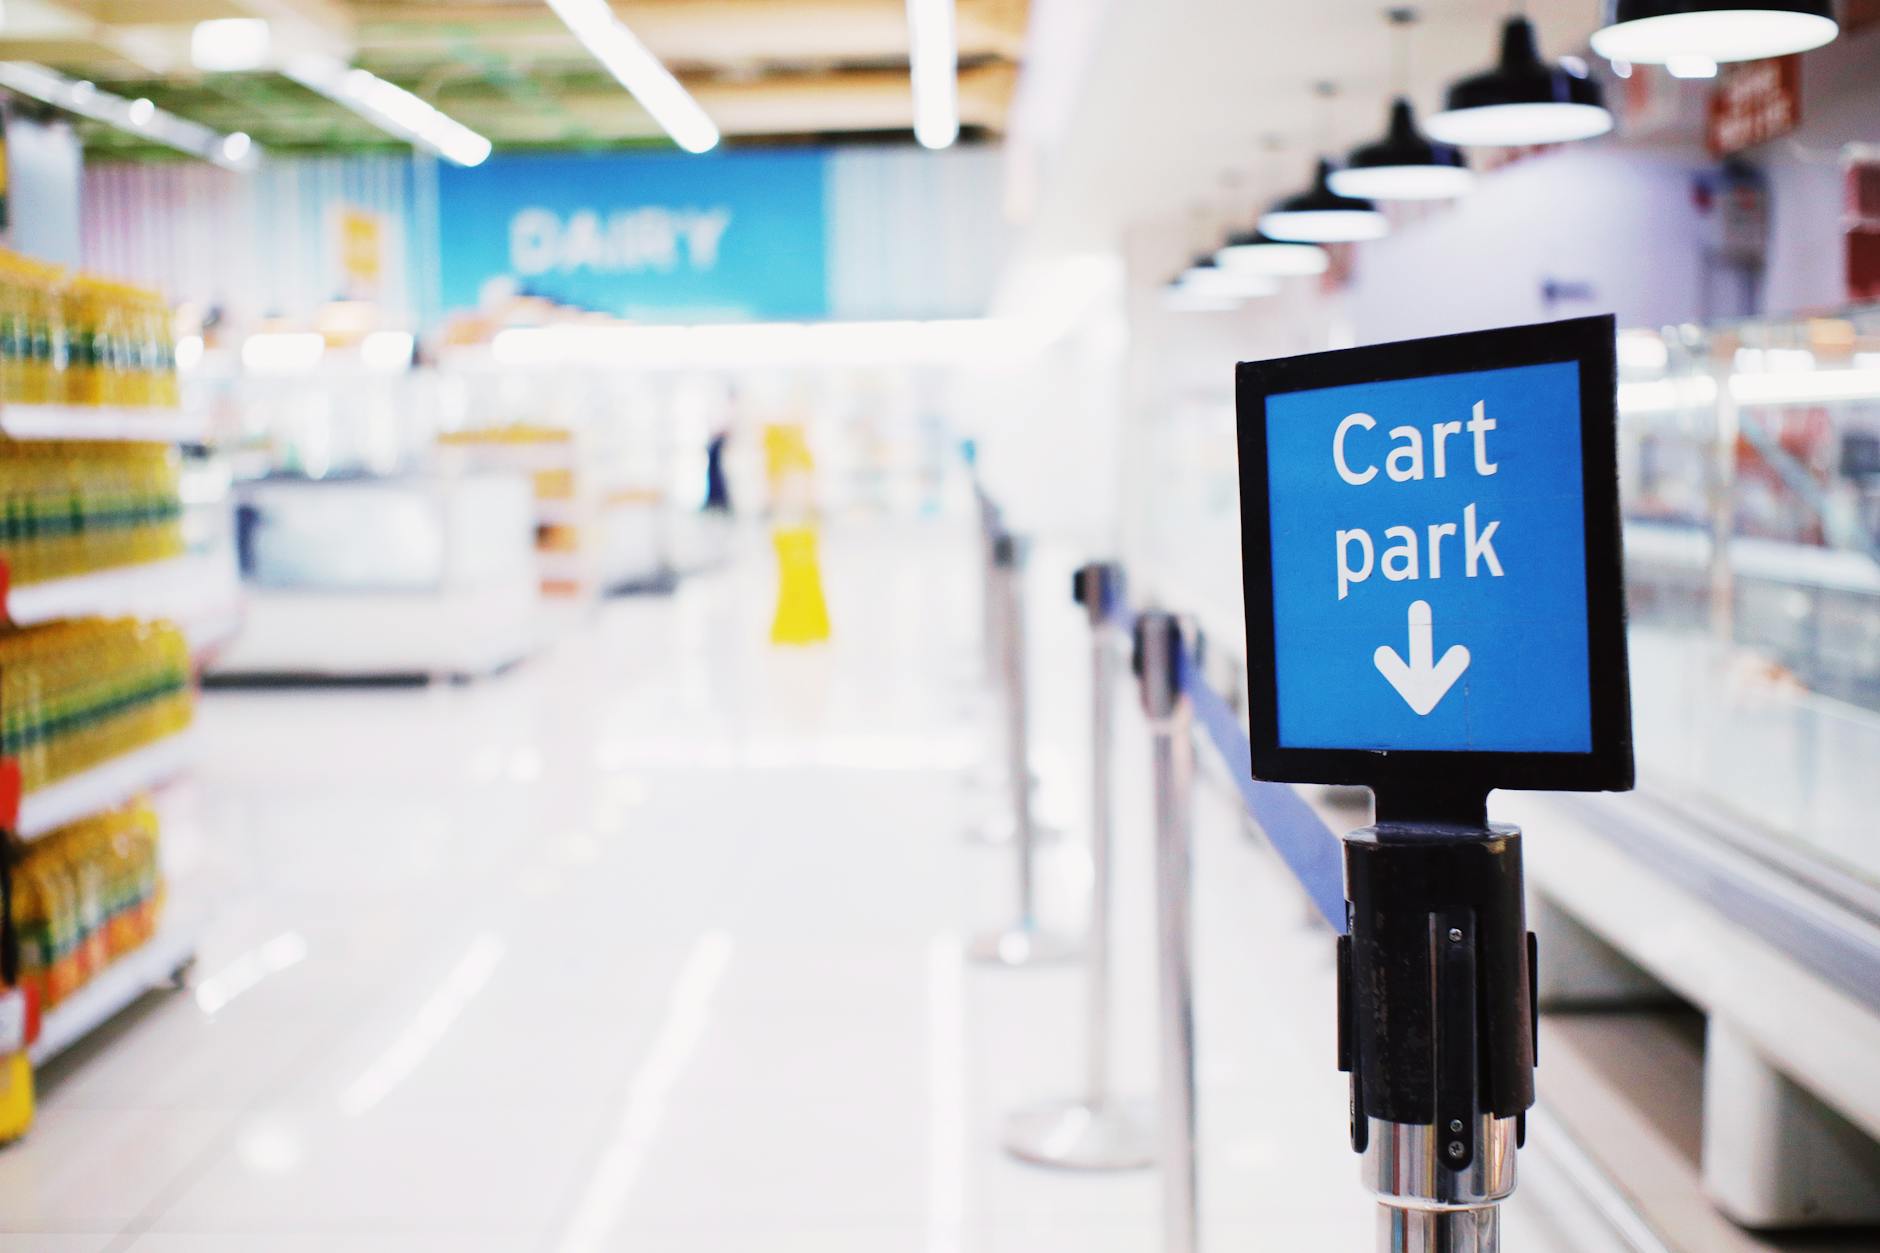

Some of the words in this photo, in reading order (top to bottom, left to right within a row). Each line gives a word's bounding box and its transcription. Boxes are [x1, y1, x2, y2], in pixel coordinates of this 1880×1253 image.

[509, 207, 731, 274] DAIRY
[1333, 400, 1498, 486] Cart
[1335, 502, 1504, 601] park
